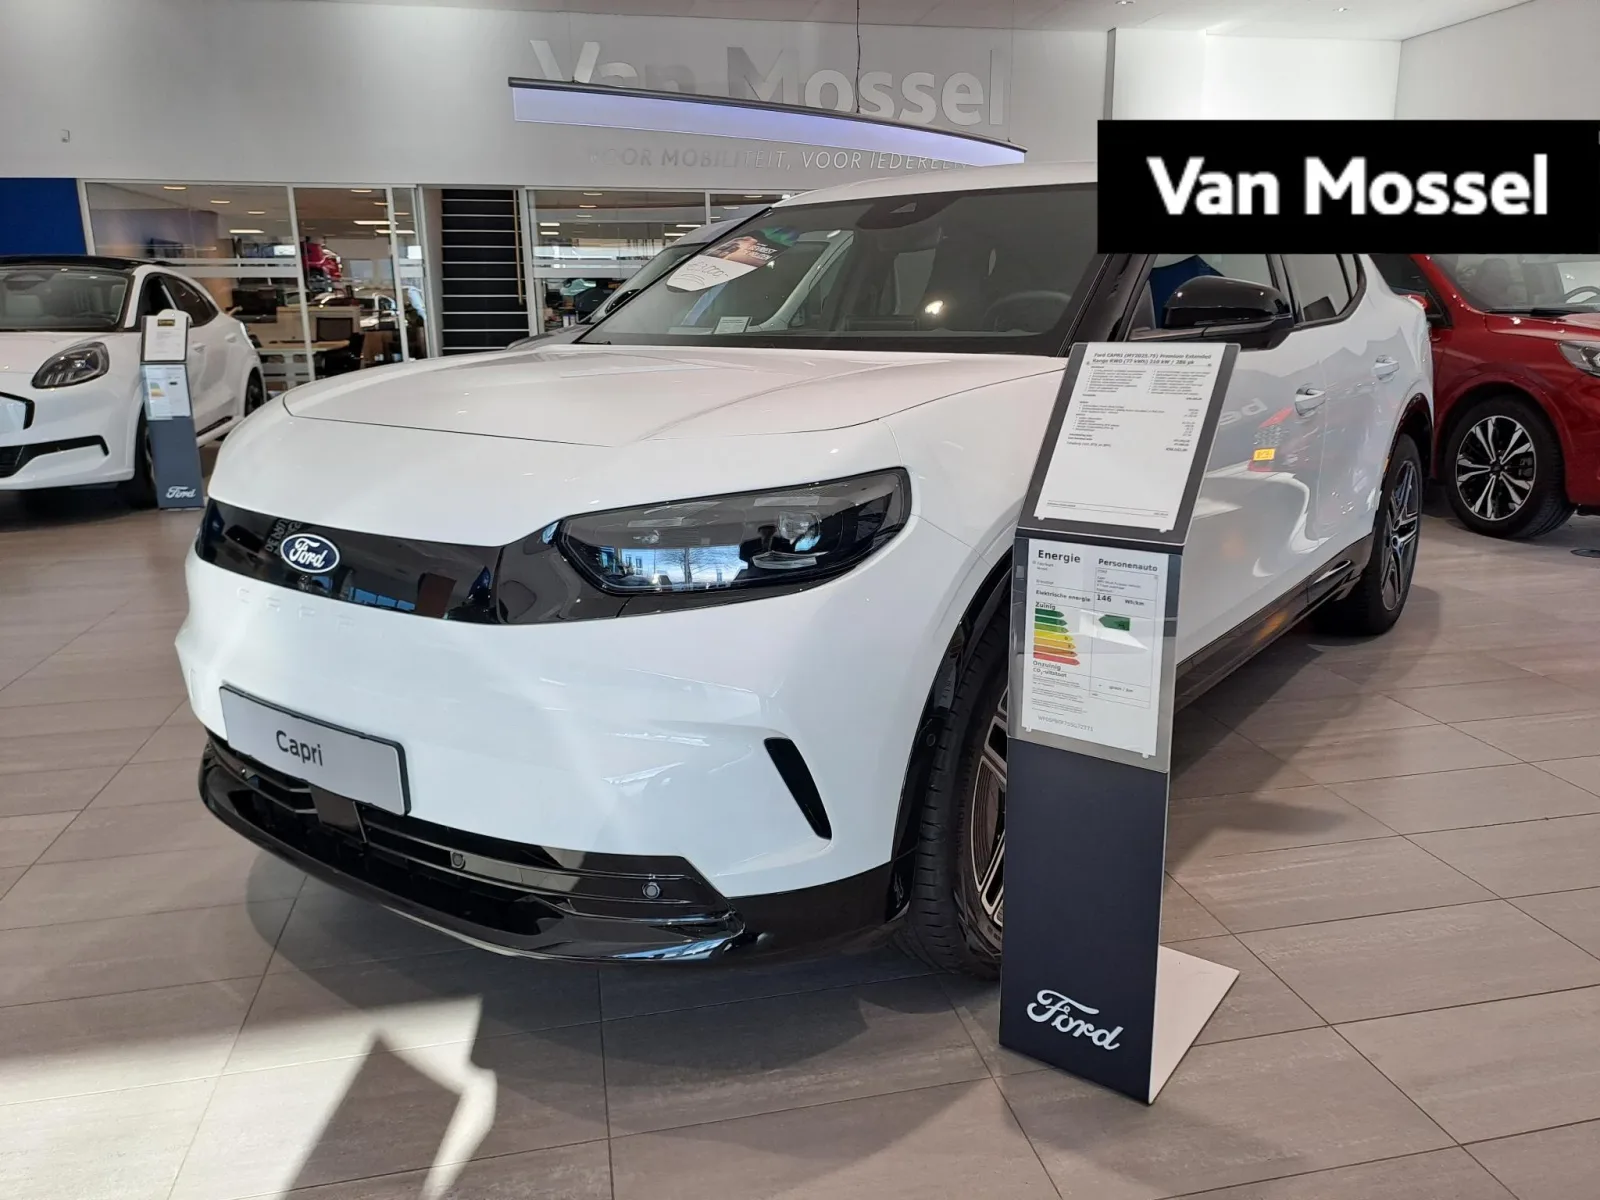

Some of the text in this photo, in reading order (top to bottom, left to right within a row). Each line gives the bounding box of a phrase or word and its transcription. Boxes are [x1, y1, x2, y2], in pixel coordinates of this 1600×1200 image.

[530, 40, 1004, 126] Van Mossel
[802, 150, 862, 169] VOOR
[165, 485, 196, 499] Ford
[289, 538, 328, 568] Ford
[1038, 549, 1081, 563] Energie
[1098, 558, 1158, 572] Personenauto
[1036, 589, 1091, 603] Elektrische energie
[1096, 594, 1112, 603] 146
[1035, 601, 1056, 611] Zuinig
[1033, 660, 1061, 671] Onzuinig
[276, 730, 323, 766] Capri
[1026, 989, 1124, 1050] Ford
